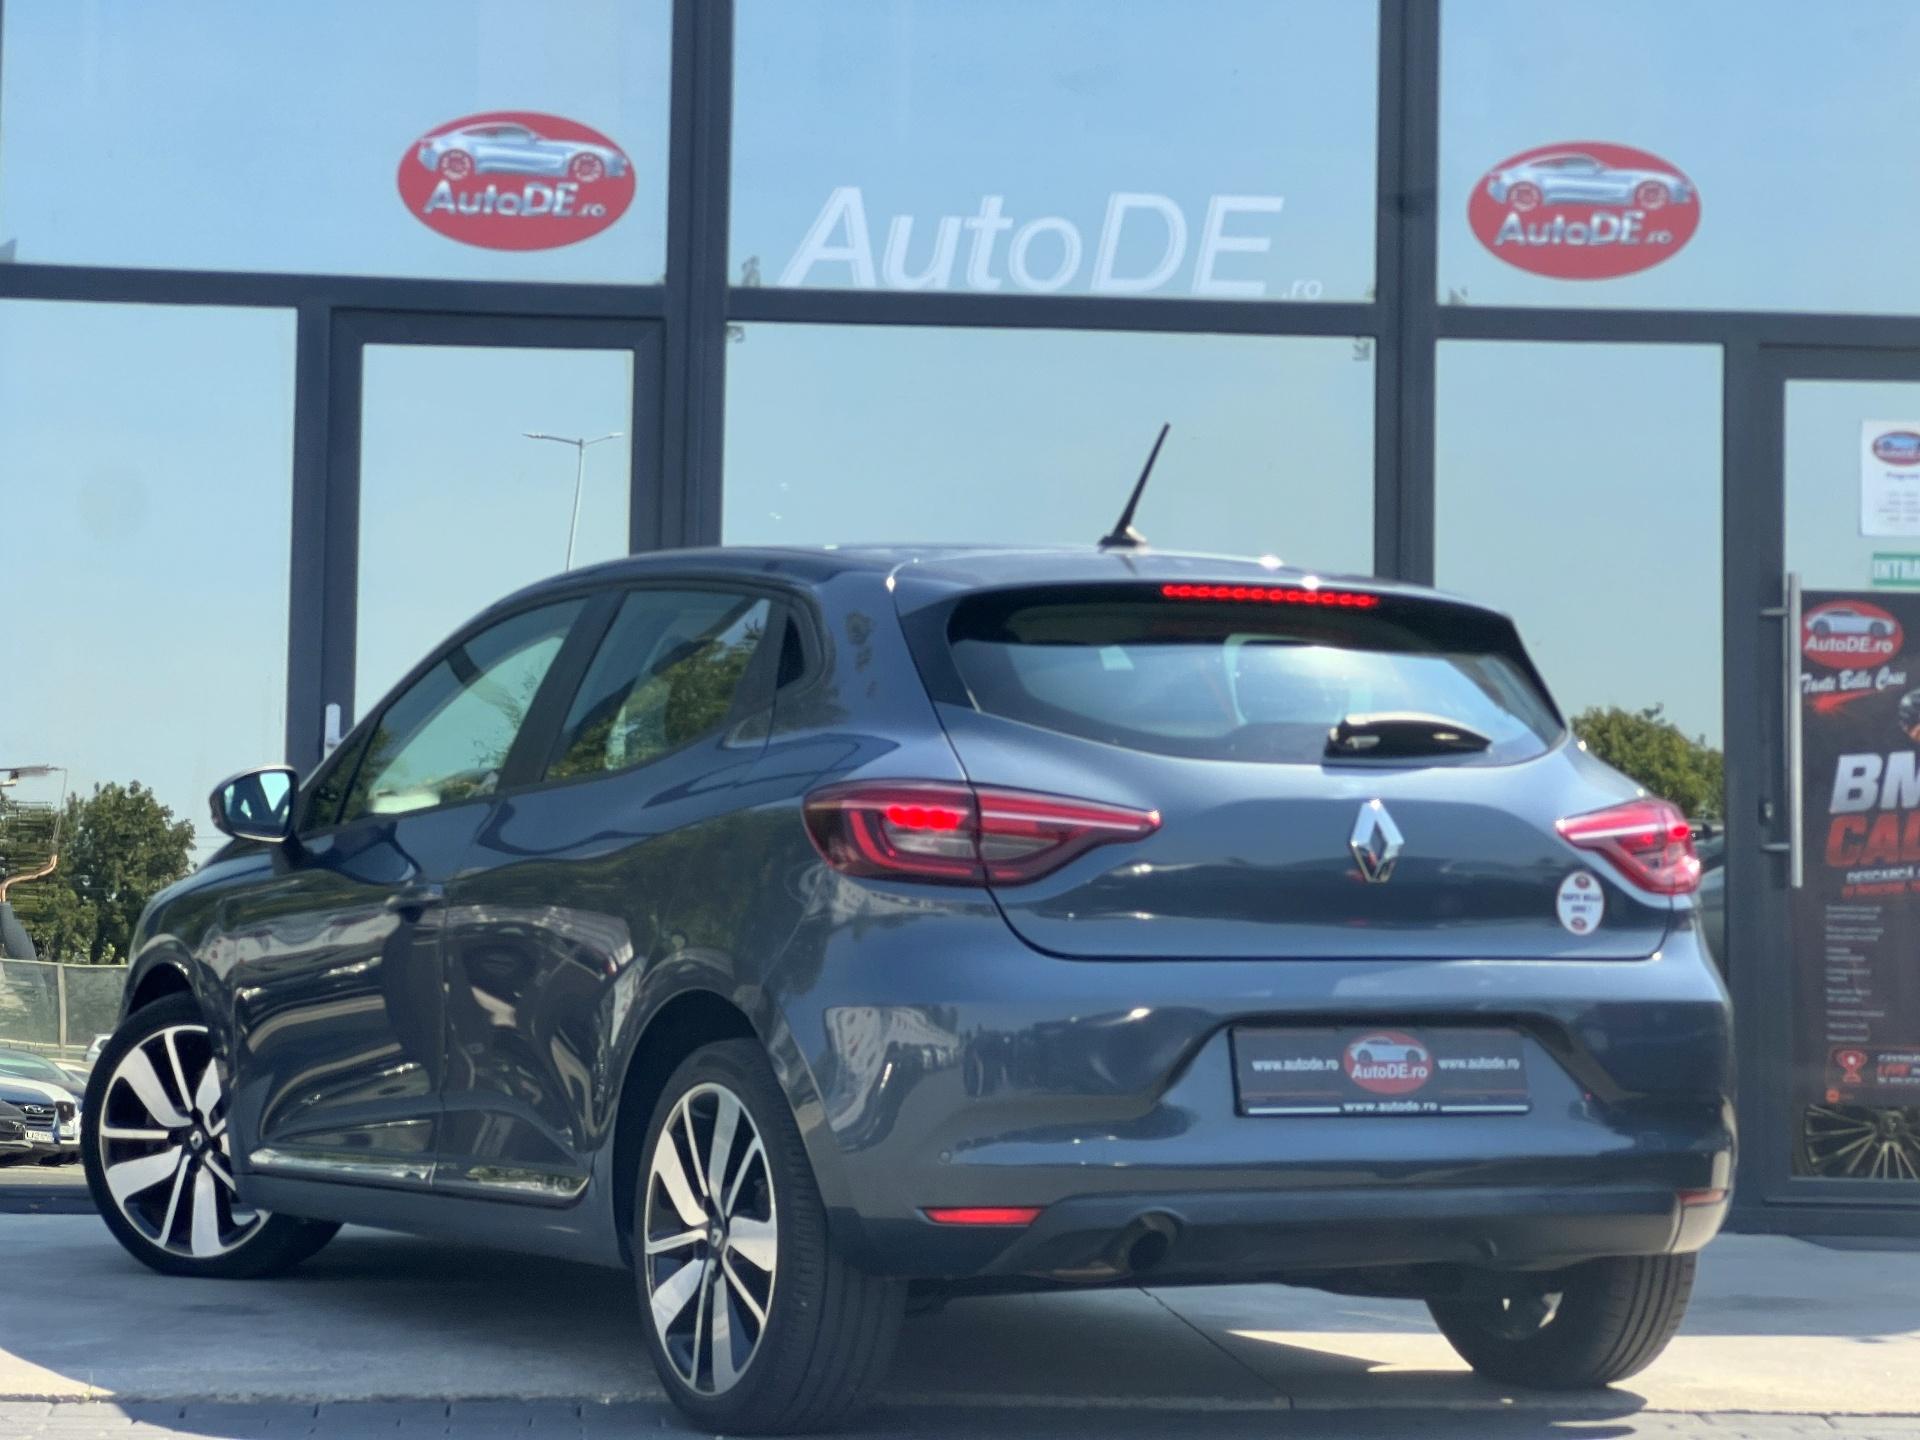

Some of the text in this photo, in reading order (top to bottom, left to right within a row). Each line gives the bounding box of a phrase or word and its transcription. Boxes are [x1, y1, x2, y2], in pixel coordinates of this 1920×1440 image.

[1805, 635, 1894, 653] AutoDE.ro
[1252, 1057, 1339, 1072] www.autode.ro
[1438, 1056, 1520, 1071] www.autode.ro
[1351, 1064, 1428, 1080] AutoDE.ro
[1343, 1101, 1438, 1112] www.autode.ro
